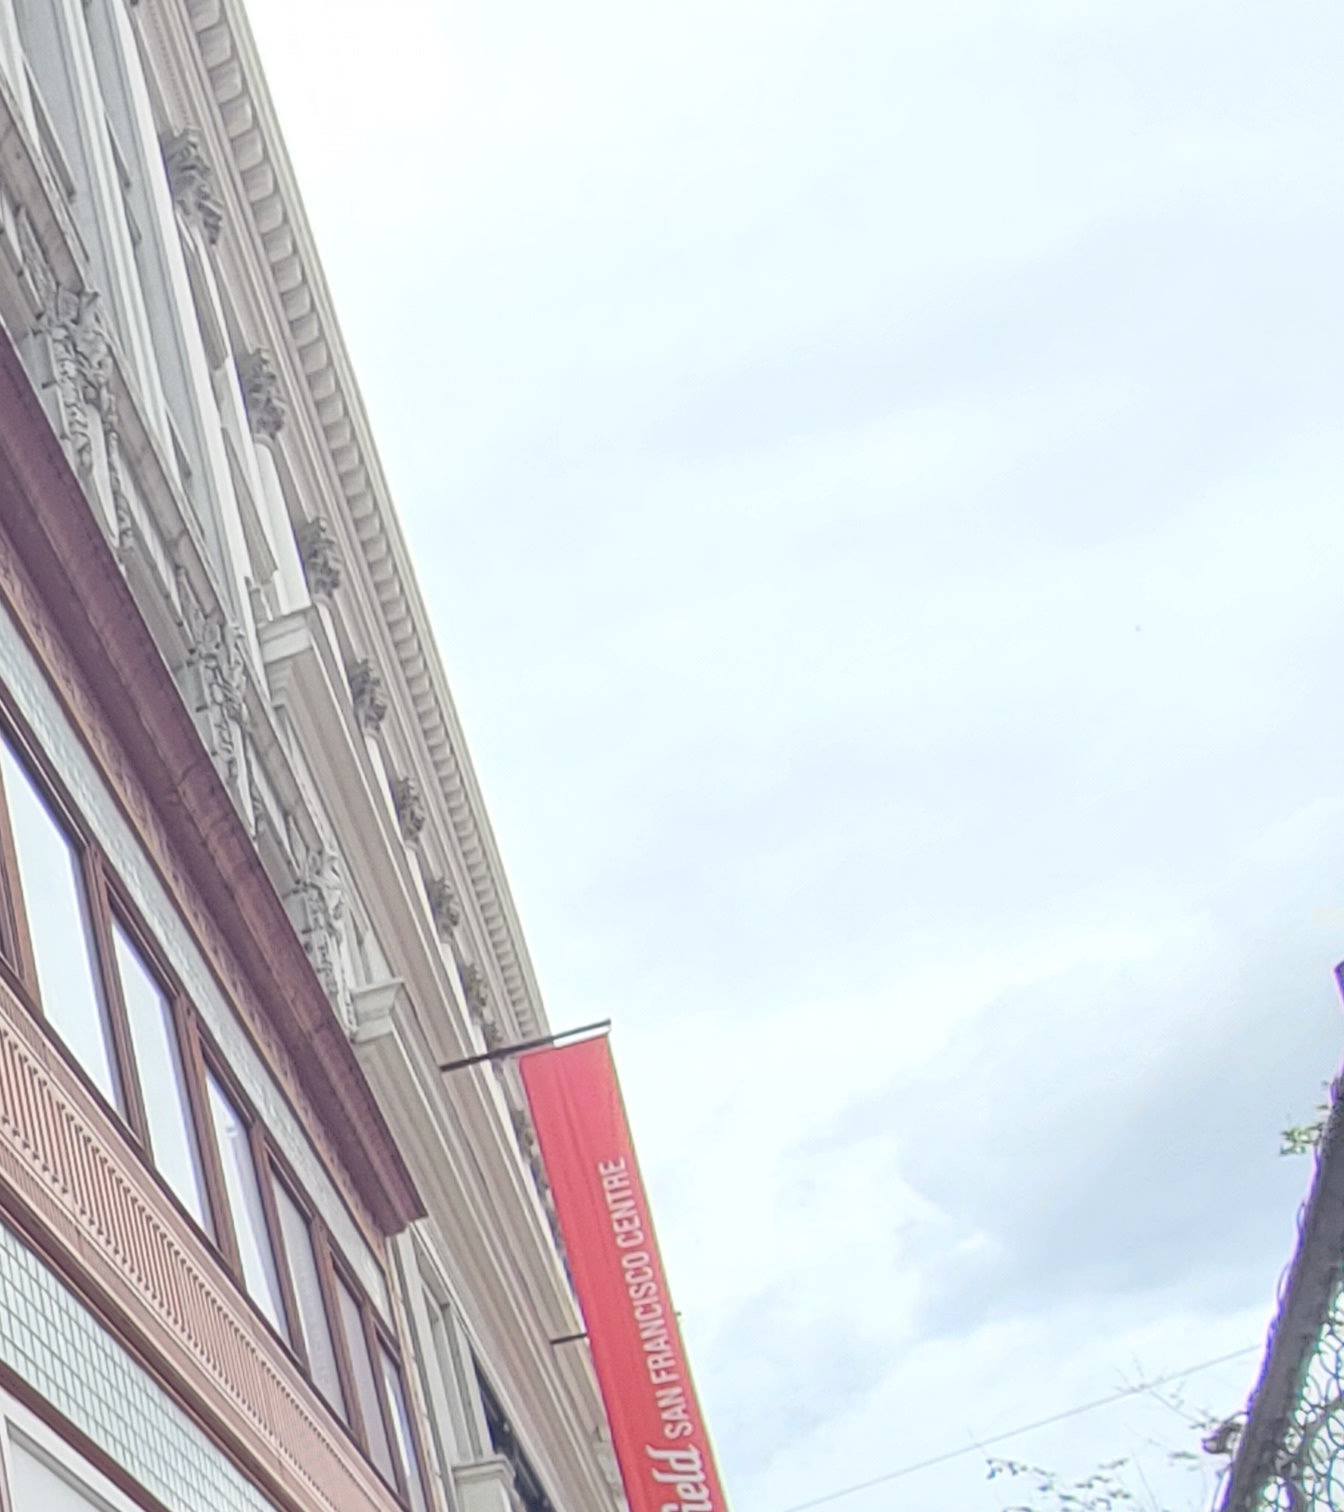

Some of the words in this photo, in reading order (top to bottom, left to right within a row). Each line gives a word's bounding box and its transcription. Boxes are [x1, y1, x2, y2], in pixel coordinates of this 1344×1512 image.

[599, 1156, 646, 1248] CENTRE
[621, 1250, 681, 1385] FRANCISCO
[655, 1386, 694, 1440] SAN
